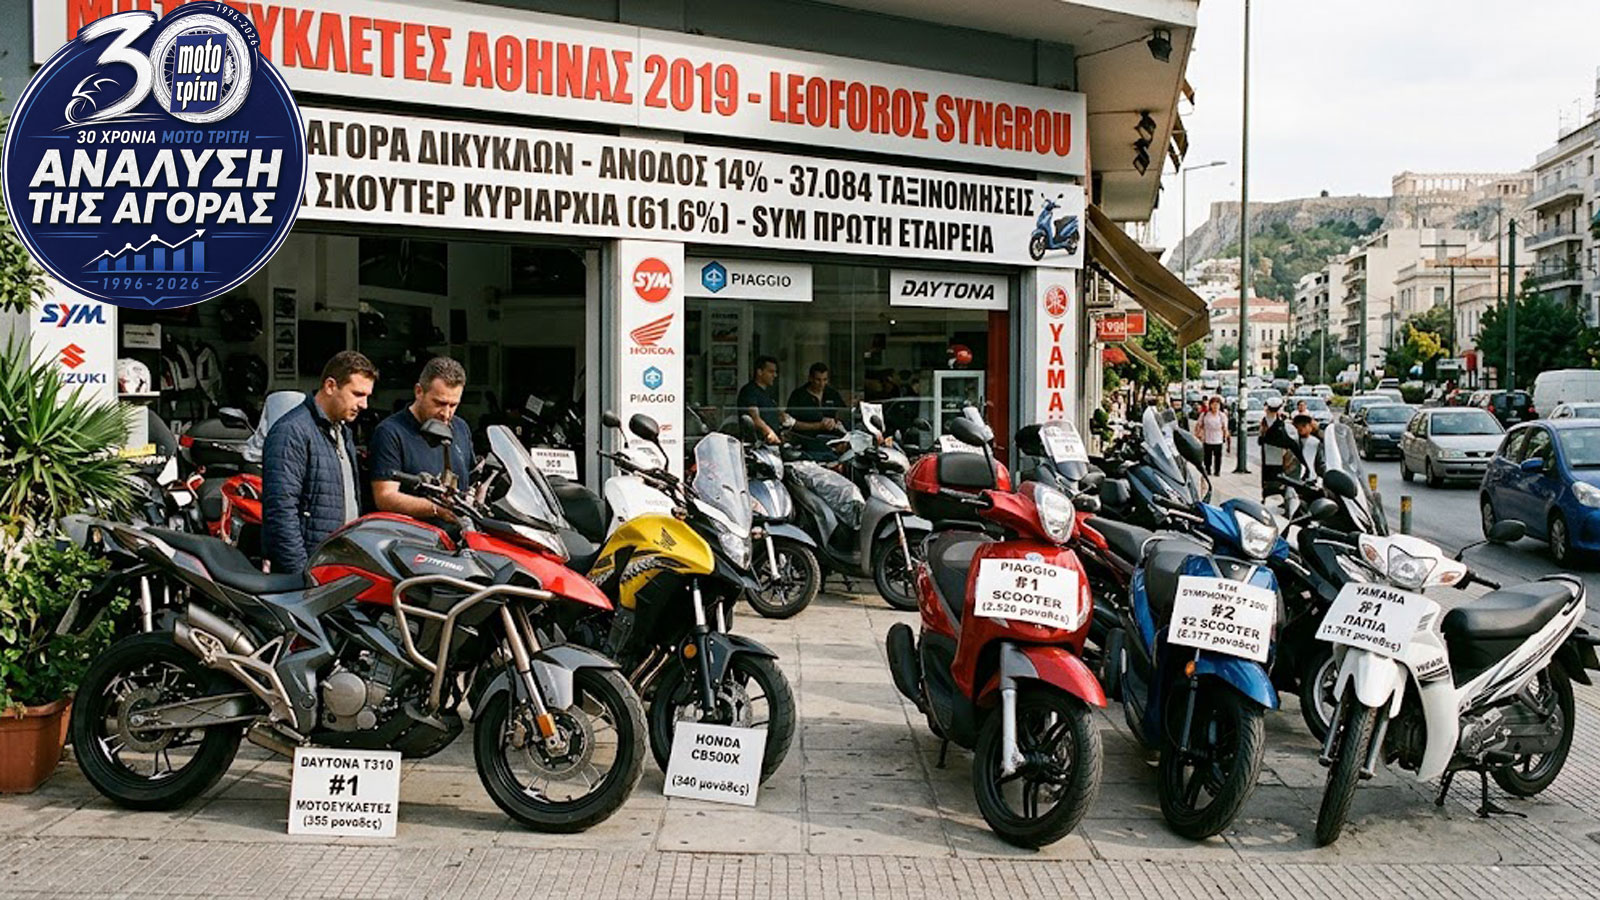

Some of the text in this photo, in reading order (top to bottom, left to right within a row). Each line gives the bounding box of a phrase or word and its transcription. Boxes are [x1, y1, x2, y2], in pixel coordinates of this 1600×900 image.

[463, 31, 633, 105] ΑΘΗΝΑΣ
[644, 54, 739, 117] 2019
[748, 93, 761, 104] -
[936, 94, 1071, 157] SYNGROU
[307, 119, 410, 163] ΑΓΟΡΑ
[418, 129, 574, 177] ΔΙΚΥΚΛΩΝ
[581, 158, 591, 167] -
[599, 146, 708, 187] ΑΝΟΔΟΣ
[714, 156, 768, 193] 14%
[790, 164, 872, 203] 37.084
[877, 174, 1034, 217] ΤΑΞΙΝΟΜΗΣΕΙΣ
[315, 171, 455, 216] ΣΚΟΥΤΕΡ
[464, 183, 620, 228] ΚΥΡΙΑΡΧΙΑ
[627, 195, 729, 234] (61.6%)
[737, 218, 746, 226] -
[752, 205, 806, 240] SYM
[813, 210, 892, 247] ΠΡΩΤΗ
[899, 218, 994, 254] ΕΤΑΙΡΕΙΑ
[633, 271, 672, 292] SYM
[731, 273, 792, 288] PIAGGIO
[901, 279, 995, 301] DAYTONA
[40, 303, 106, 328] SYM
[61, 372, 106, 384] ZUKI
[630, 393, 675, 403] PIAGGIO
[1001, 561, 1057, 578] PIAGGIO
[993, 590, 1062, 609] SCOOTER
[1211, 604, 1236, 621] #2
[1200, 618, 1260, 640] SCOOTER
[1343, 614, 1386, 634] ΠΑΠΙΑ
[695, 733, 741, 749] HONDA
[301, 756, 394, 771] DAYTONA T310
[691, 748, 740, 764] CB500X
[329, 774, 359, 796] #1
[672, 774, 697, 787] (340
[303, 815, 328, 827] (355
